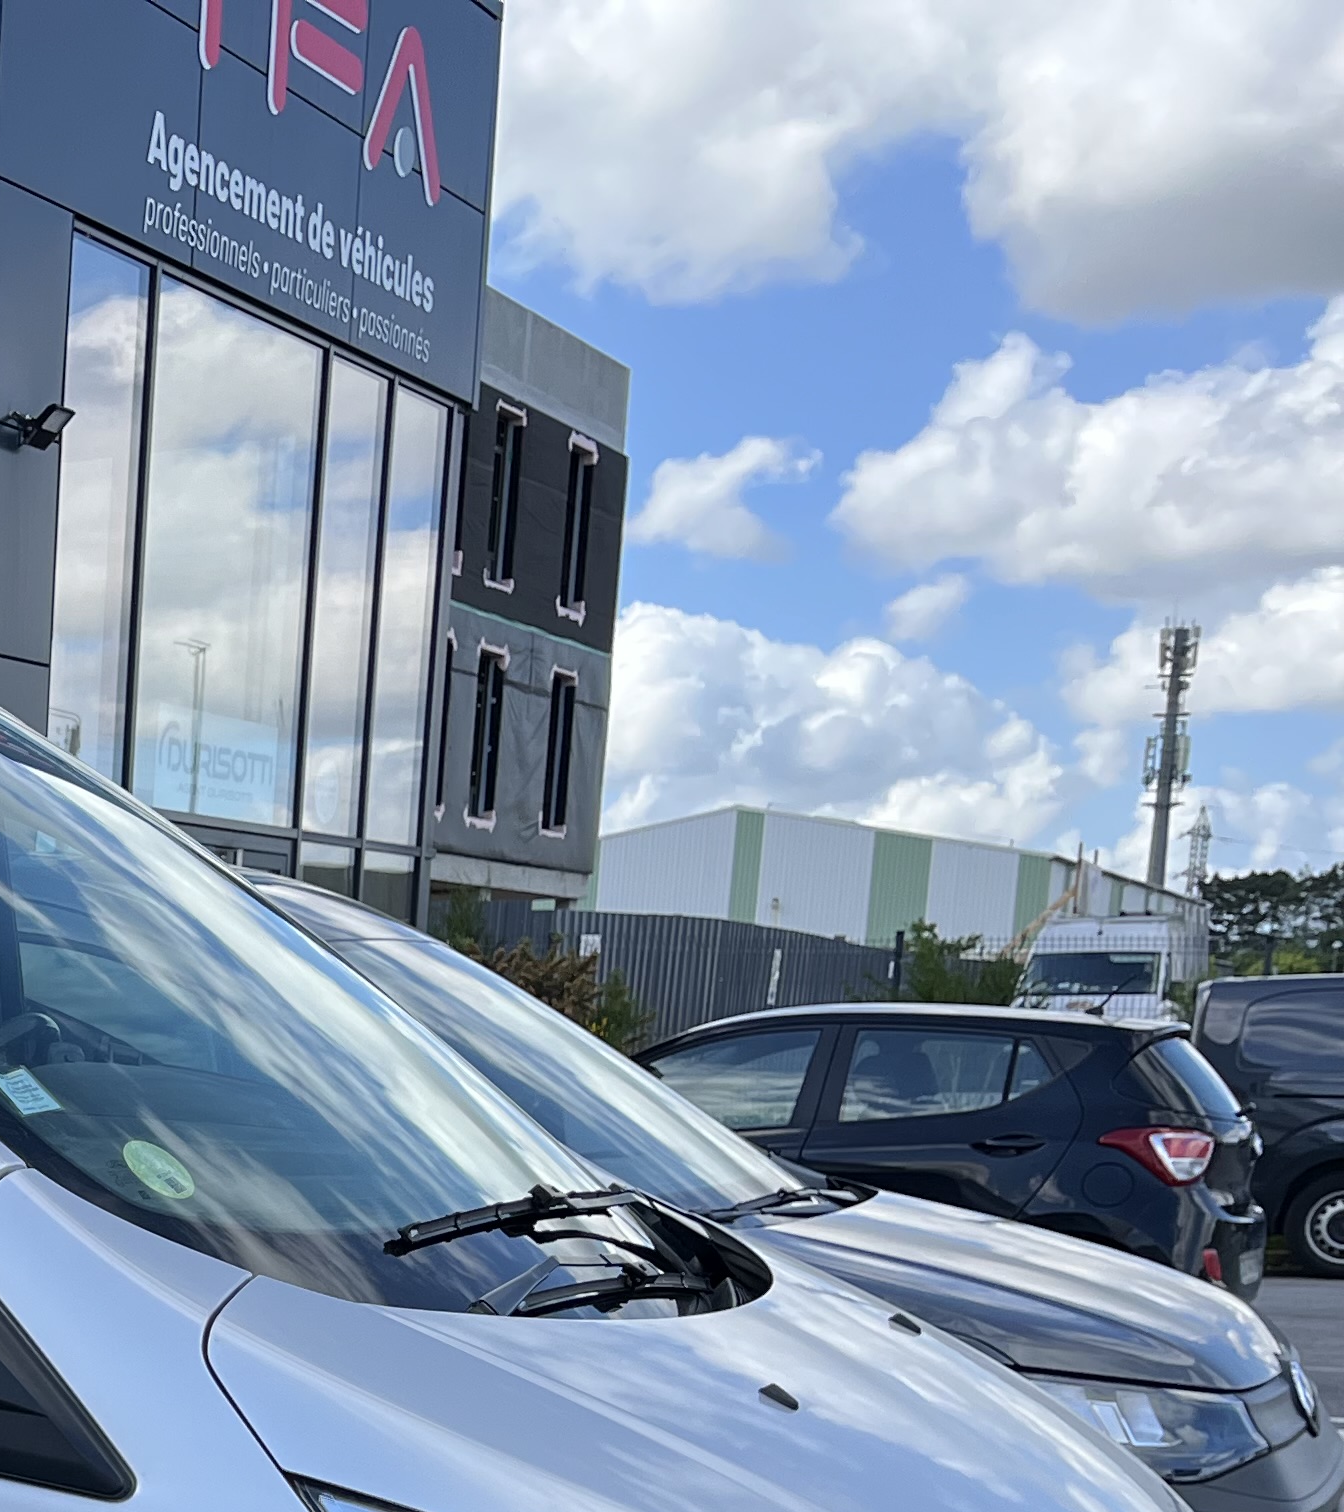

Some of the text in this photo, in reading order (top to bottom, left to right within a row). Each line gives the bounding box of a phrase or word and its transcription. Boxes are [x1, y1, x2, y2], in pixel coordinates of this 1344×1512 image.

[143, 196, 431, 363] professionnels particuliers passionnés
[146, 110, 435, 313] Agencement de véhicules
[167, 736, 273, 786] DURISOTTI
